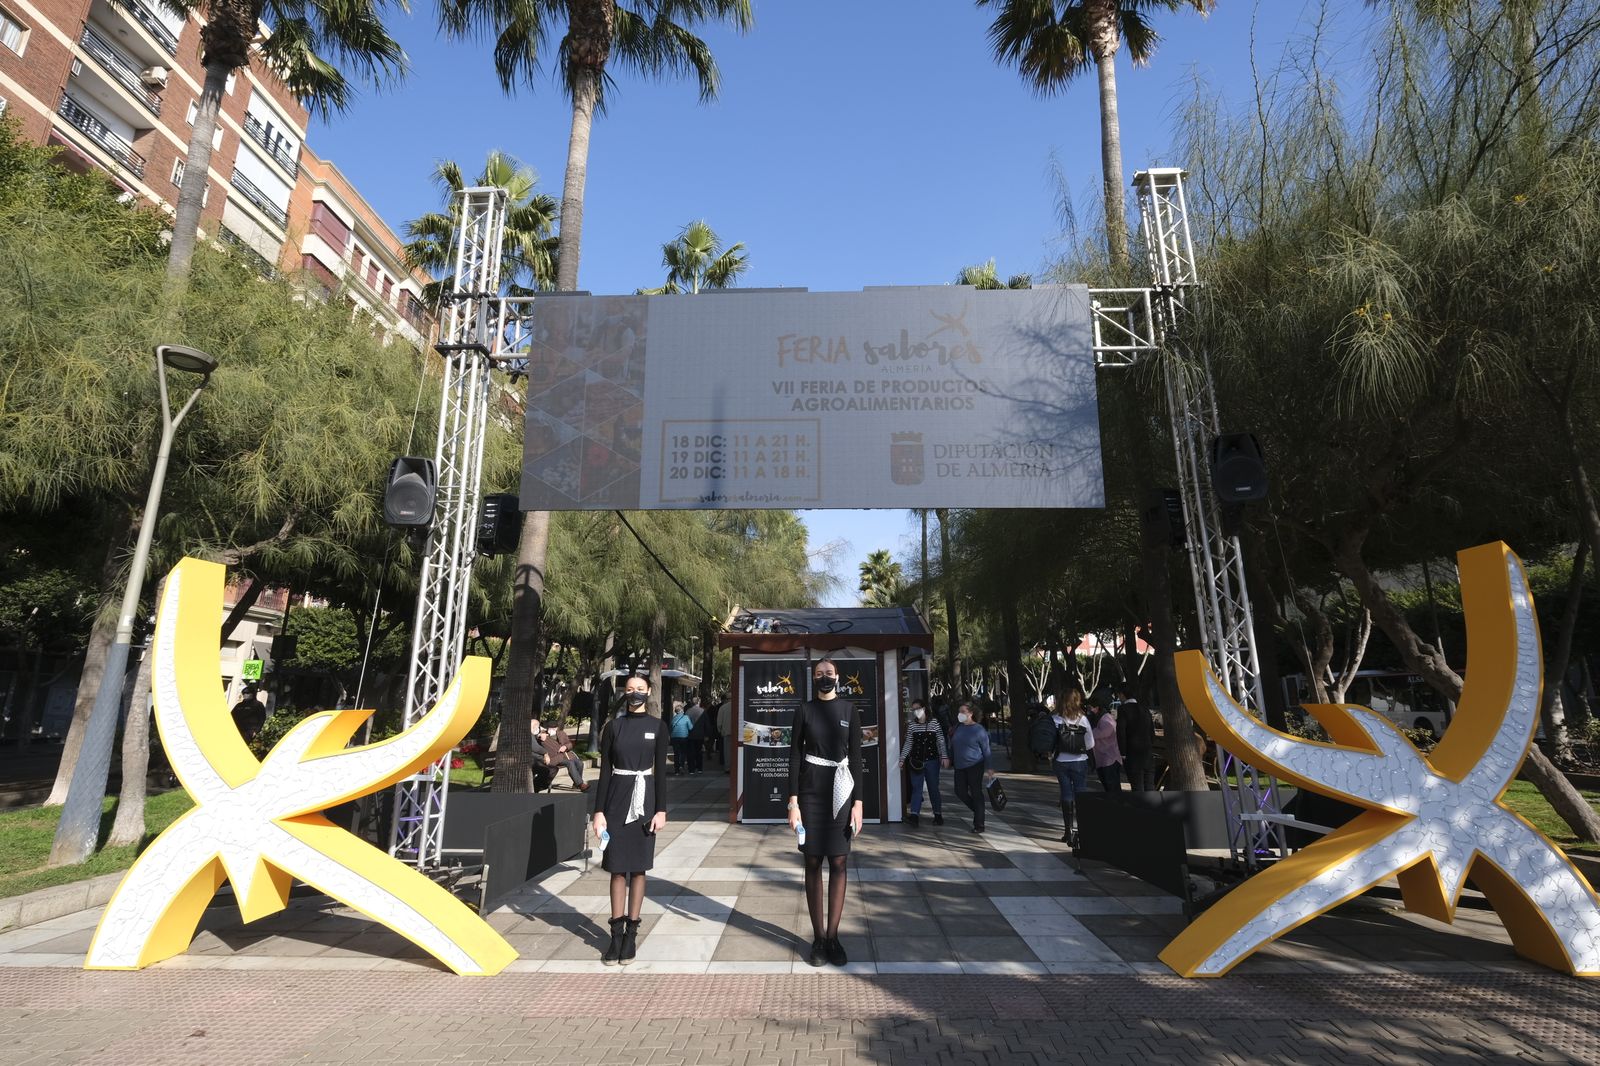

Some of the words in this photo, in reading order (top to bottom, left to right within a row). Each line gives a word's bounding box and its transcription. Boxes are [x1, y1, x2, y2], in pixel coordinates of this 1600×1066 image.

[776, 333, 851, 369] FERIA
[863, 328, 984, 366] sabores
[772, 381, 794, 395] VII
[801, 380, 847, 394] FERIA
[854, 380, 874, 394] DE
[881, 379, 989, 394] PRODUCTOS
[791, 396, 975, 411] AGROALIMENTARIOS
[671, 435, 689, 449] 18
[694, 434, 727, 448] DIC:
[734, 434, 749, 448] 11
[755, 434, 767, 448] A
[772, 434, 788, 448] 21
[796, 434, 810, 447] H.
[933, 440, 1054, 459] DIPUTACIÓN
[671, 451, 689, 465] 19
[694, 450, 727, 464] DIC:
[734, 450, 749, 464] 11
[755, 450, 767, 464] A
[772, 450, 788, 464] 21
[796, 450, 810, 463] H.
[670, 467, 689, 481] 20
[694, 466, 727, 480] DIC:
[734, 466, 749, 480] 11
[755, 466, 767, 480] A
[772, 466, 790, 480] 18
[796, 466, 810, 479] H.
[936, 463, 961, 477] DE
[756, 681, 794, 695] sabores
